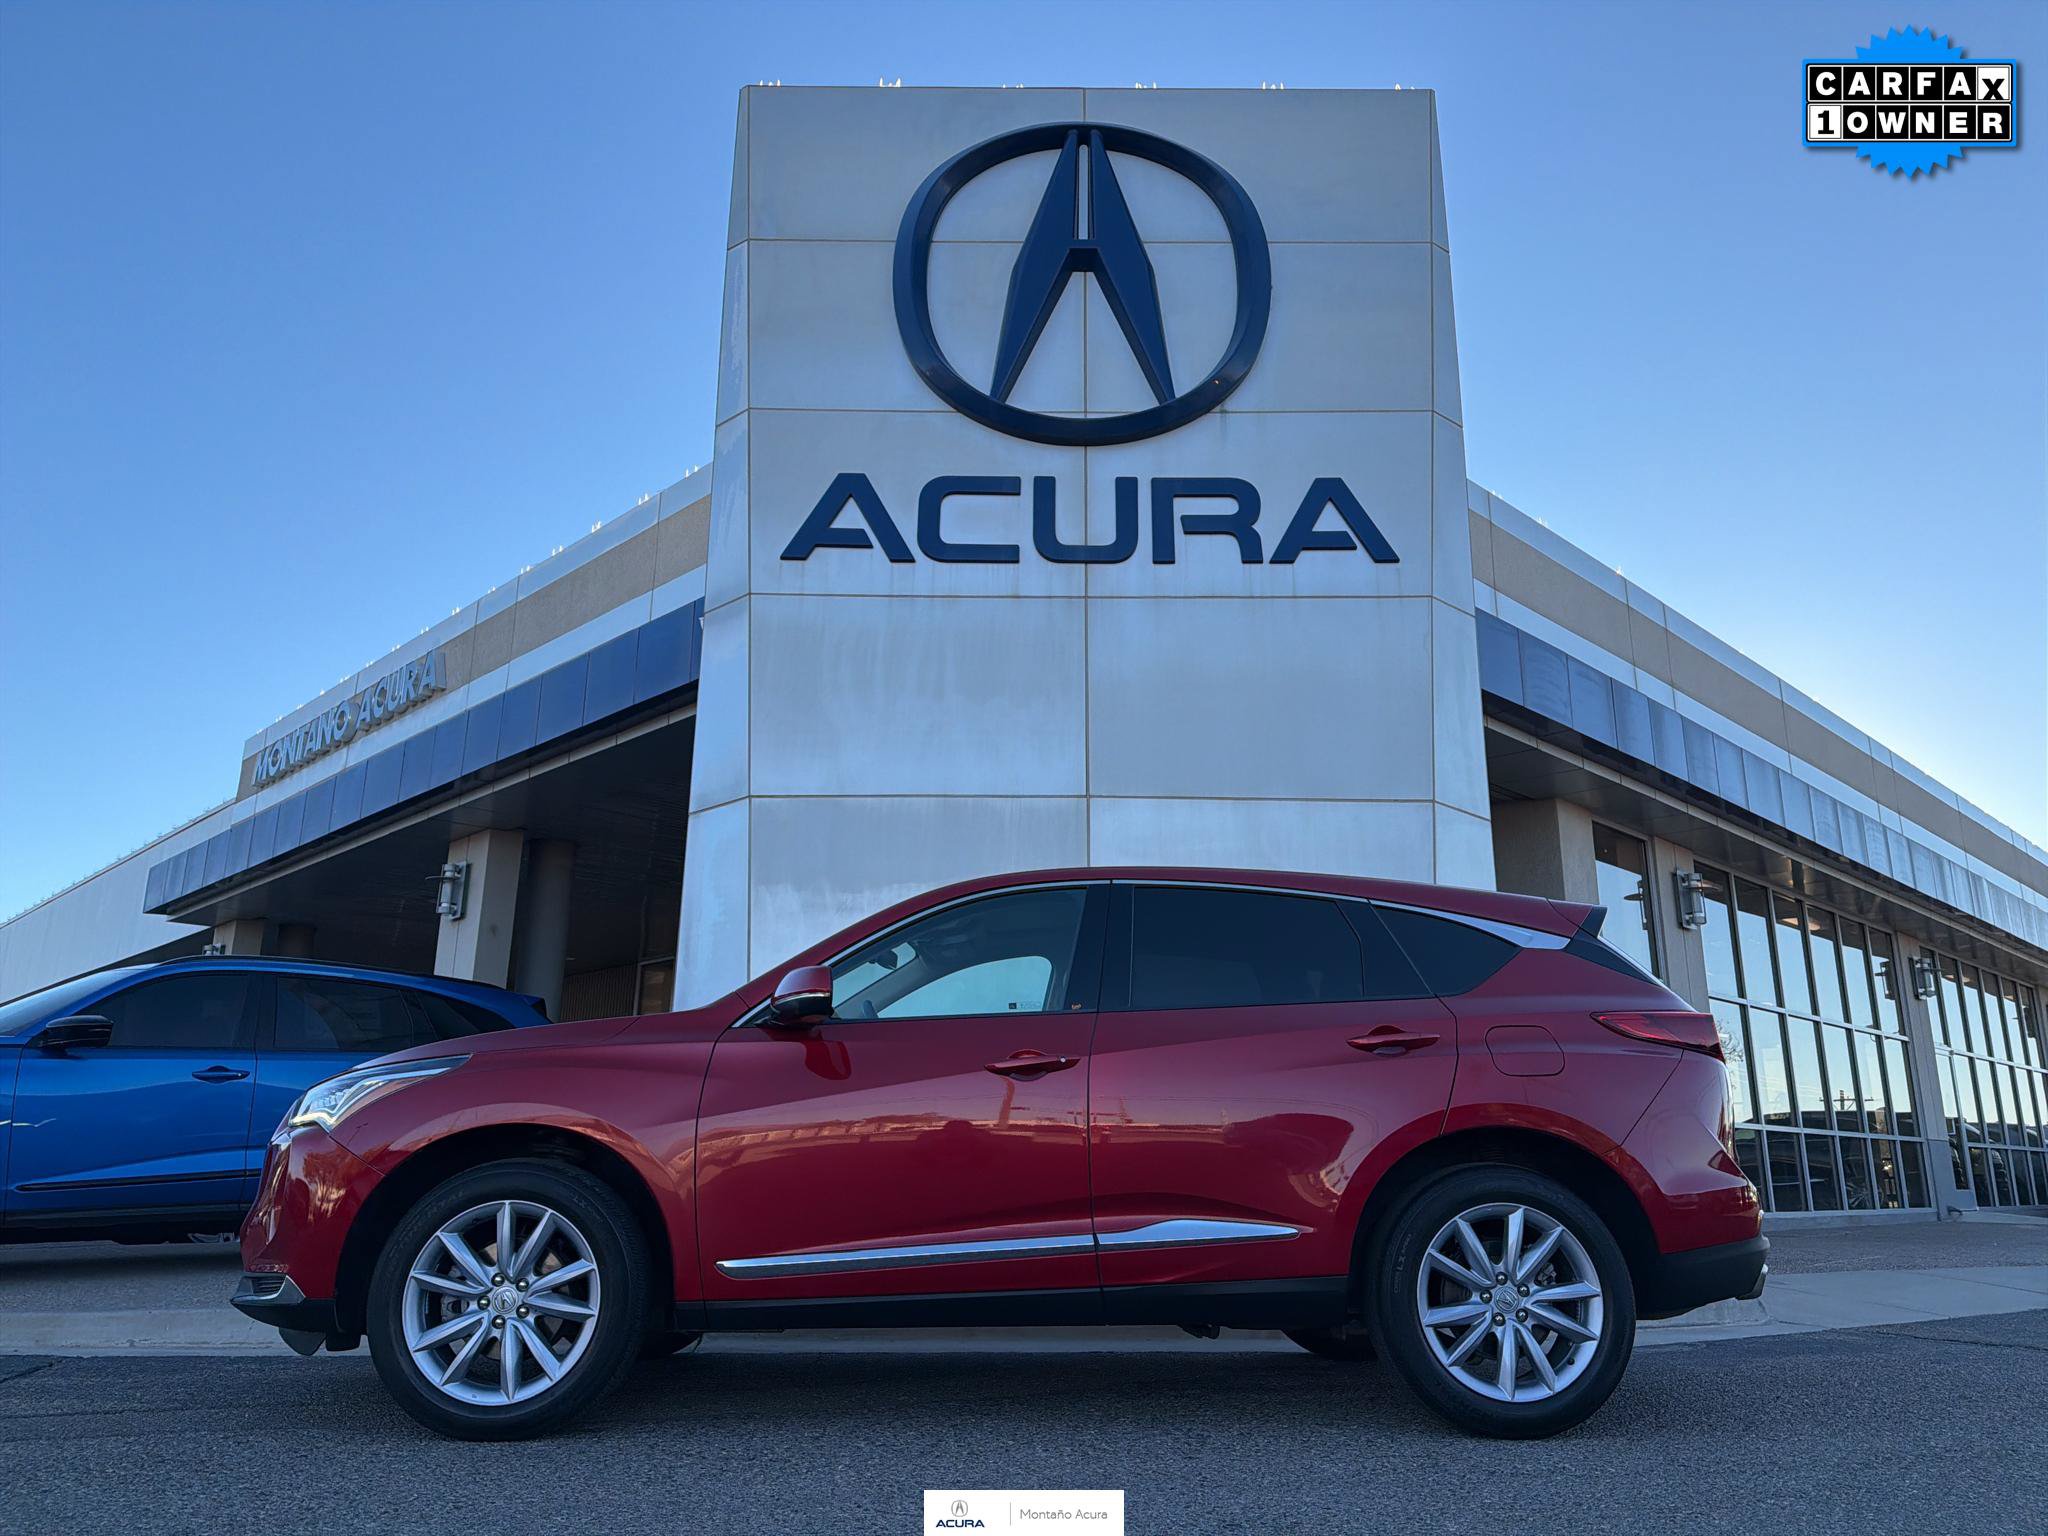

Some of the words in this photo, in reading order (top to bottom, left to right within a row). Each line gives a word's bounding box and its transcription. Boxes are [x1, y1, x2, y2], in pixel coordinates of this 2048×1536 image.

[780, 473, 1400, 564] ACURA
[252, 699, 353, 785] MONTANO
[355, 649, 440, 730] ACURA
